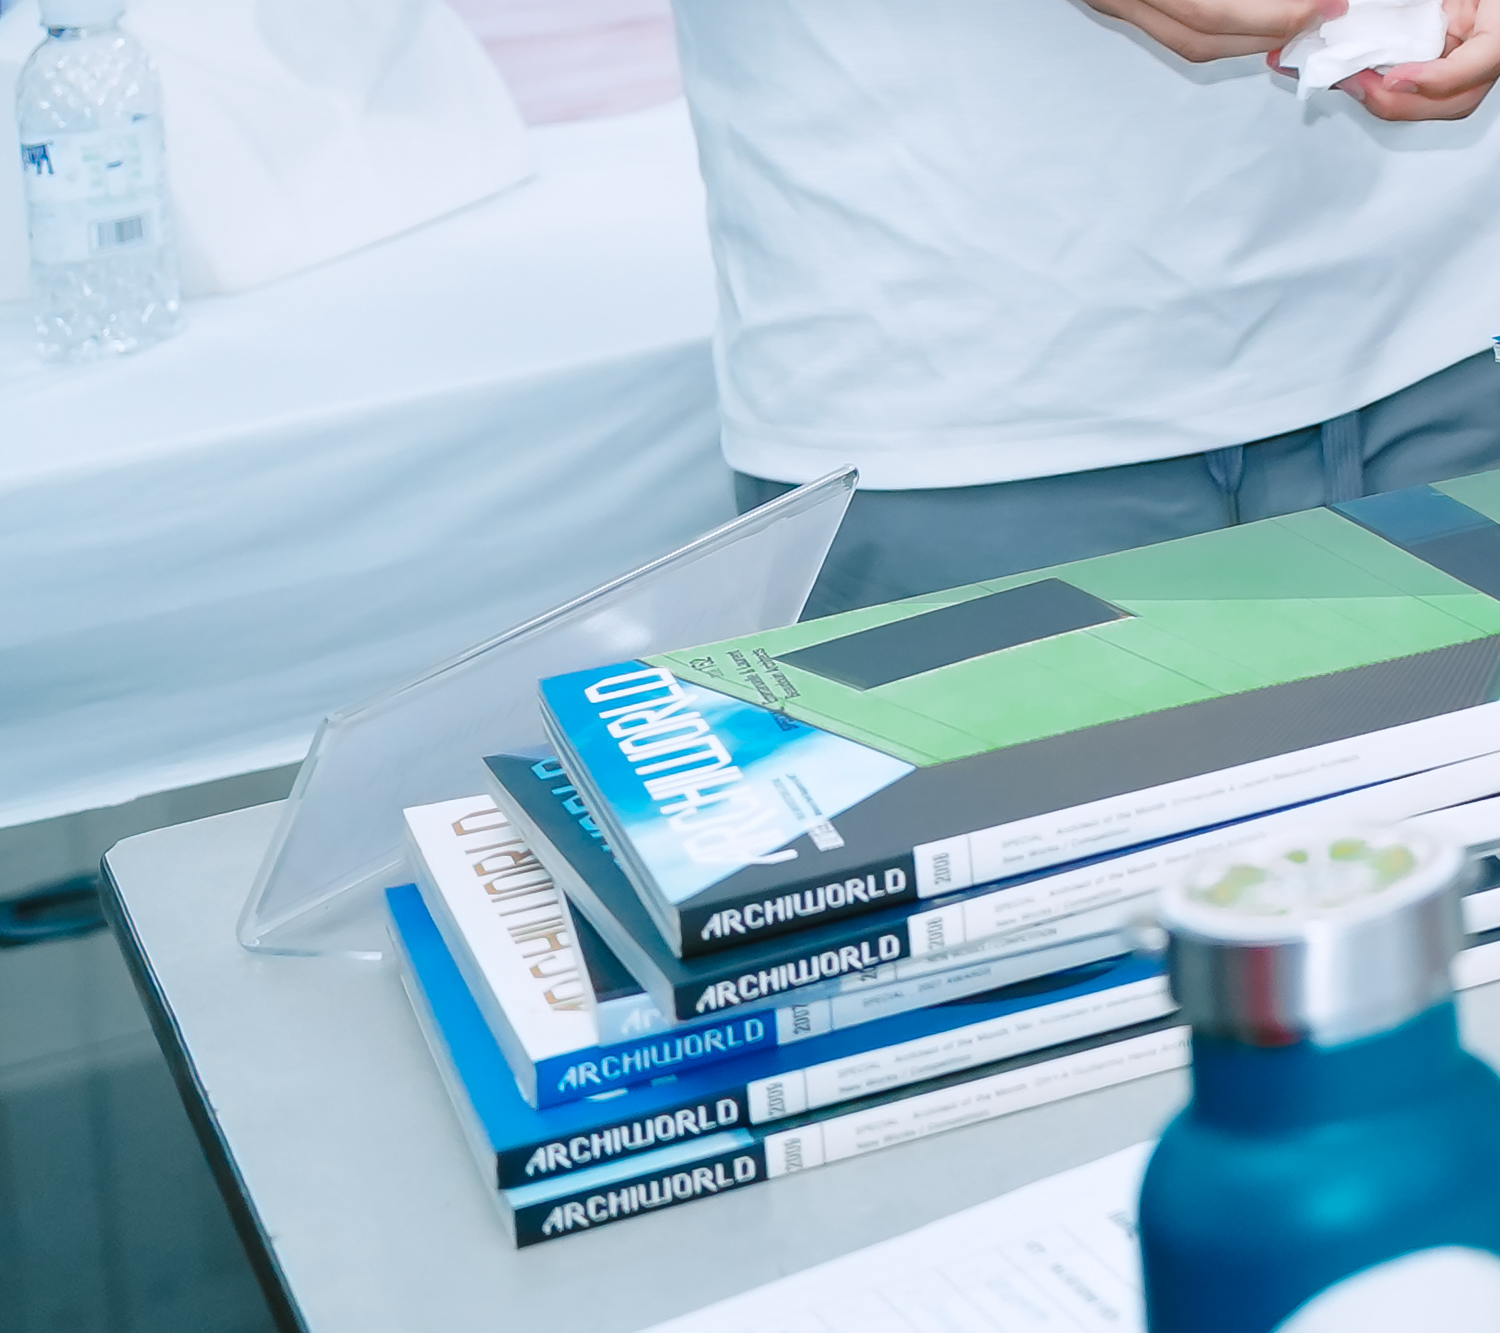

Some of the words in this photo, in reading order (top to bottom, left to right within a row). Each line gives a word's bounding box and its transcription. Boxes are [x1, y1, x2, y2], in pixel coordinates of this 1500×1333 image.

[584, 666, 799, 865] ARCHIWORLD
[701, 867, 907, 942] ARCHIWORLD
[696, 934, 901, 1014] ARCHIWORLD
[557, 1017, 765, 1093] ARCHIWORLD
[525, 1098, 740, 1177] ARCHIWORLD
[542, 1155, 757, 1235] ARCHIWORLD
